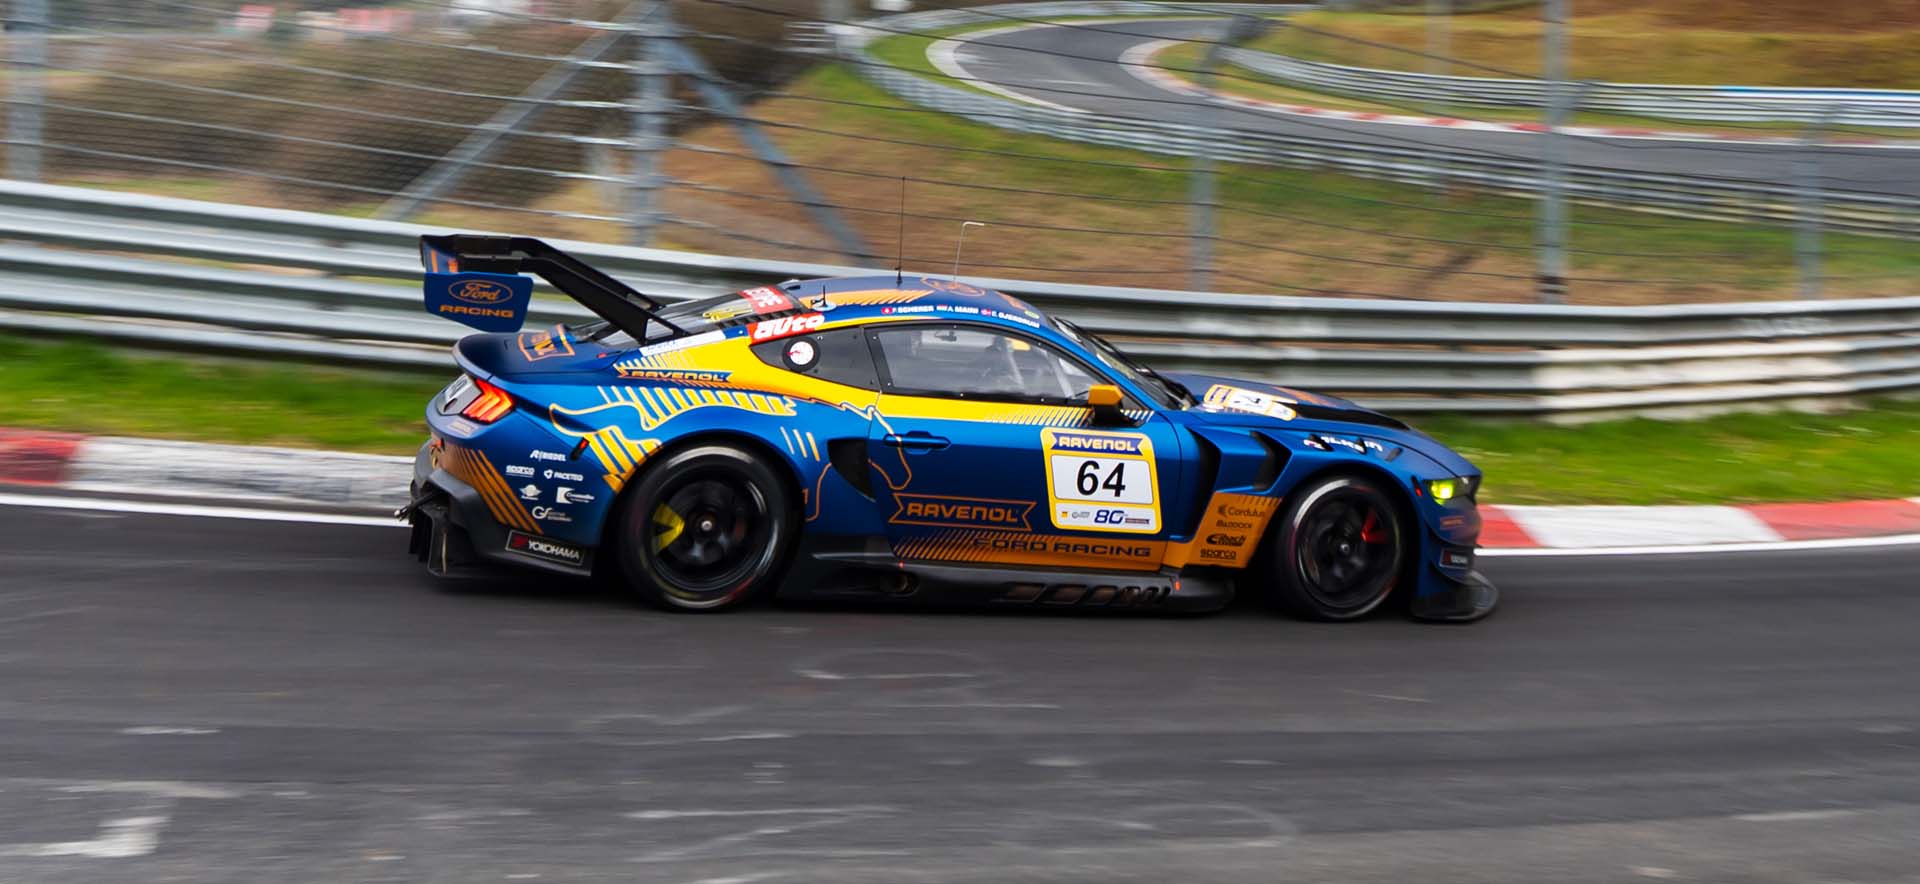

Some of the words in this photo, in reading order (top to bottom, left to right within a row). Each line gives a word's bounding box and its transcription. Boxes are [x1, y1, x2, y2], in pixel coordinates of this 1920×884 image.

[460, 282, 501, 301] Ford
[439, 304, 515, 318] RACING
[753, 314, 825, 339] auto
[631, 371, 725, 381] RAVENOL
[1059, 436, 1136, 452] RAVENOL
[1077, 460, 1126, 497] 64
[907, 502, 1019, 523] RAVENOL
[1094, 509, 1125, 524] 80
[528, 540, 580, 560] YOKOHAMA
[973, 537, 1047, 552] FORD
[1053, 542, 1151, 557] RACING
